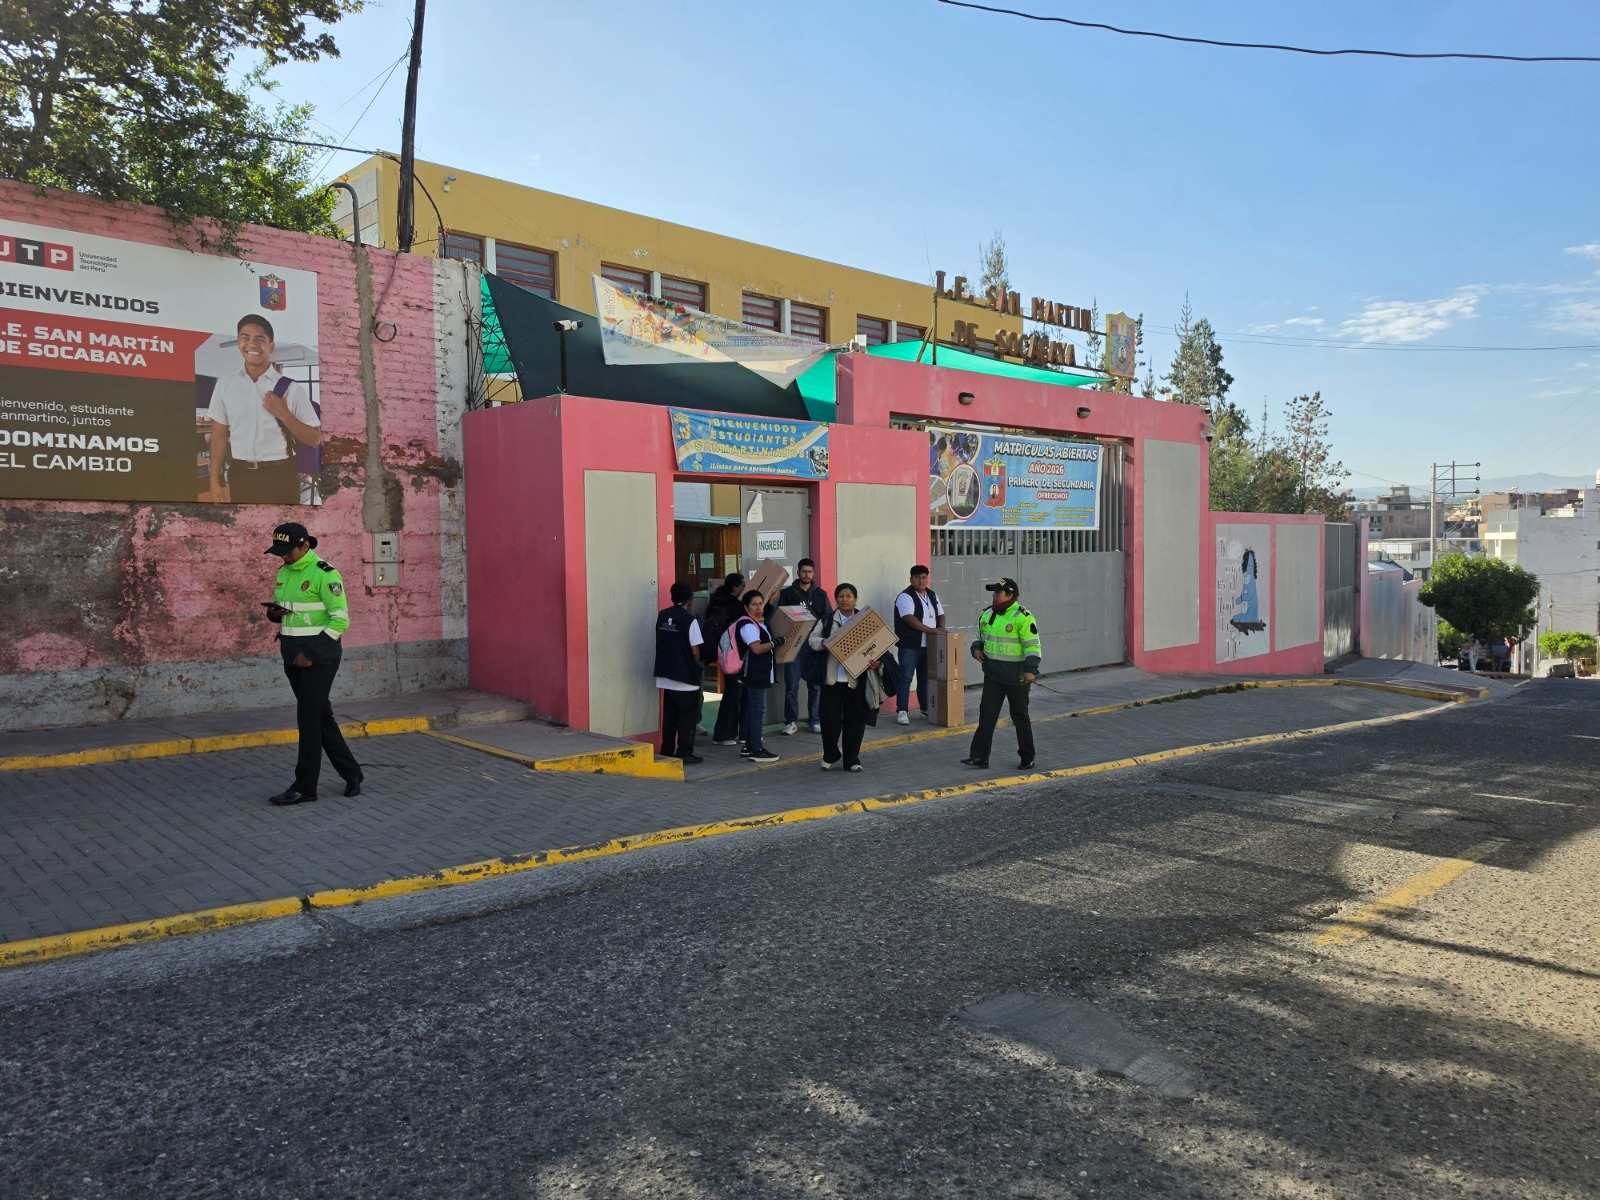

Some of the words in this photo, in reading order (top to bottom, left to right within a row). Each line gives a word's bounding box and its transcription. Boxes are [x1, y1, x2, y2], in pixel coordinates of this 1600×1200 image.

[79, 252, 117, 262] Universidad
[80, 257, 117, 269] Tecnológica
[90, 265, 106, 273] Perú
[985, 285, 1020, 315] SAN
[1031, 296, 1092, 331] MARTIN
[34, 326, 82, 344] SAN
[89, 332, 174, 354] MARTÍN
[953, 319, 979, 348] DE
[995, 329, 1077, 366] SOCABAYA
[28, 342, 147, 367] SOCABAYA
[0, 397, 67, 413] ienvenido,
[70, 404, 134, 417] estudiante
[72, 414, 112, 427] juntos
[710, 430, 796, 446] ESTUDIANTES
[993, 441, 1054, 459] MATRICULAS
[1055, 447, 1098, 462] ABIERTAS
[33, 454, 132, 473] CAMBIO
[1029, 461, 1046, 473] AÑO
[1047, 465, 1065, 475] 2026
[1008, 477, 1040, 488] PRIMERO
[1041, 479, 1051, 488] DE
[1052, 479, 1094, 490] SECUNDARIA
[1037, 491, 1069, 500] OFRECEMOS
[758, 540, 784, 551] INGRESO
[862, 643, 877, 658] ONPE
